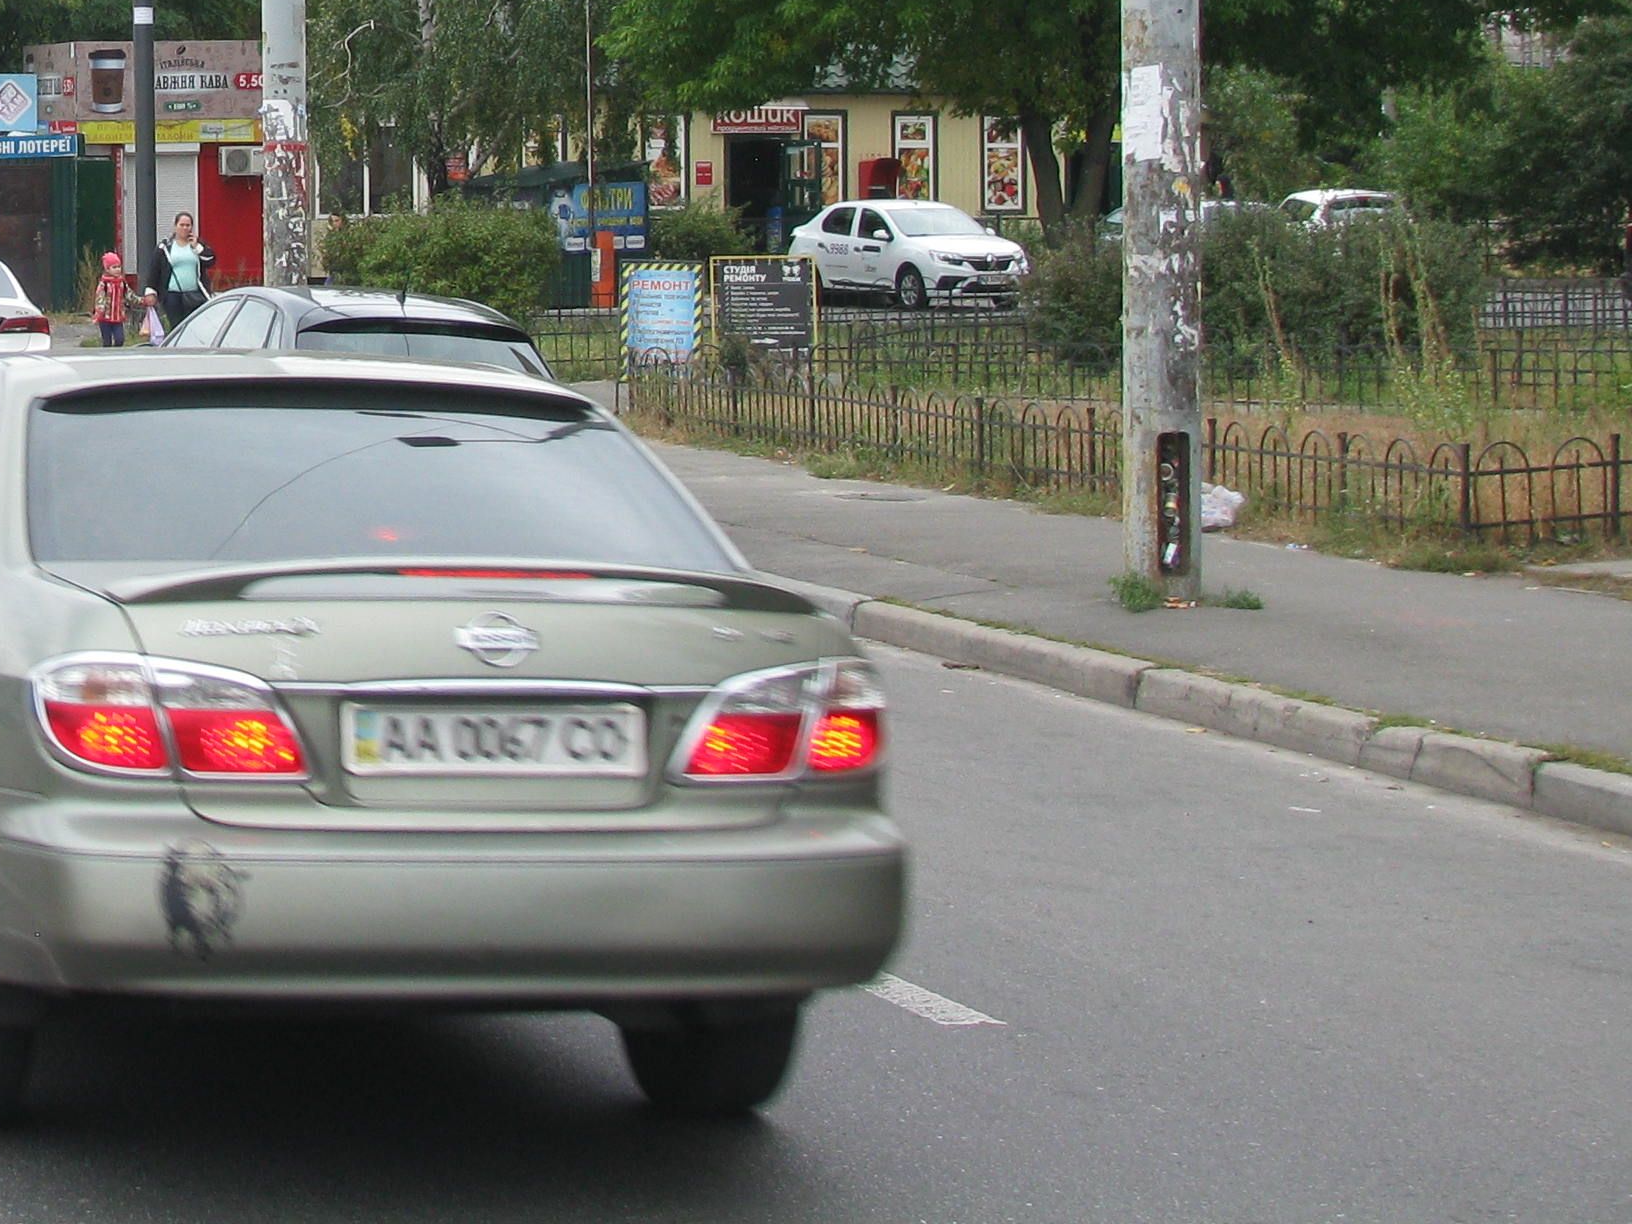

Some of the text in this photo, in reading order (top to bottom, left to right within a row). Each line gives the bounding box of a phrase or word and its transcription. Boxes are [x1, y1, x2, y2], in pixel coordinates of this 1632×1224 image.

[154, 74, 228, 90] АВЖНЯ КАВА
[18, 137, 71, 155] ЛОТЕРЕЇ
[723, 265, 756, 275] СТУДІЯ
[723, 274, 767, 283] РЕМОНТУ
[631, 280, 690, 291] РЕМОНТ
[374, 715, 443, 762] AA
